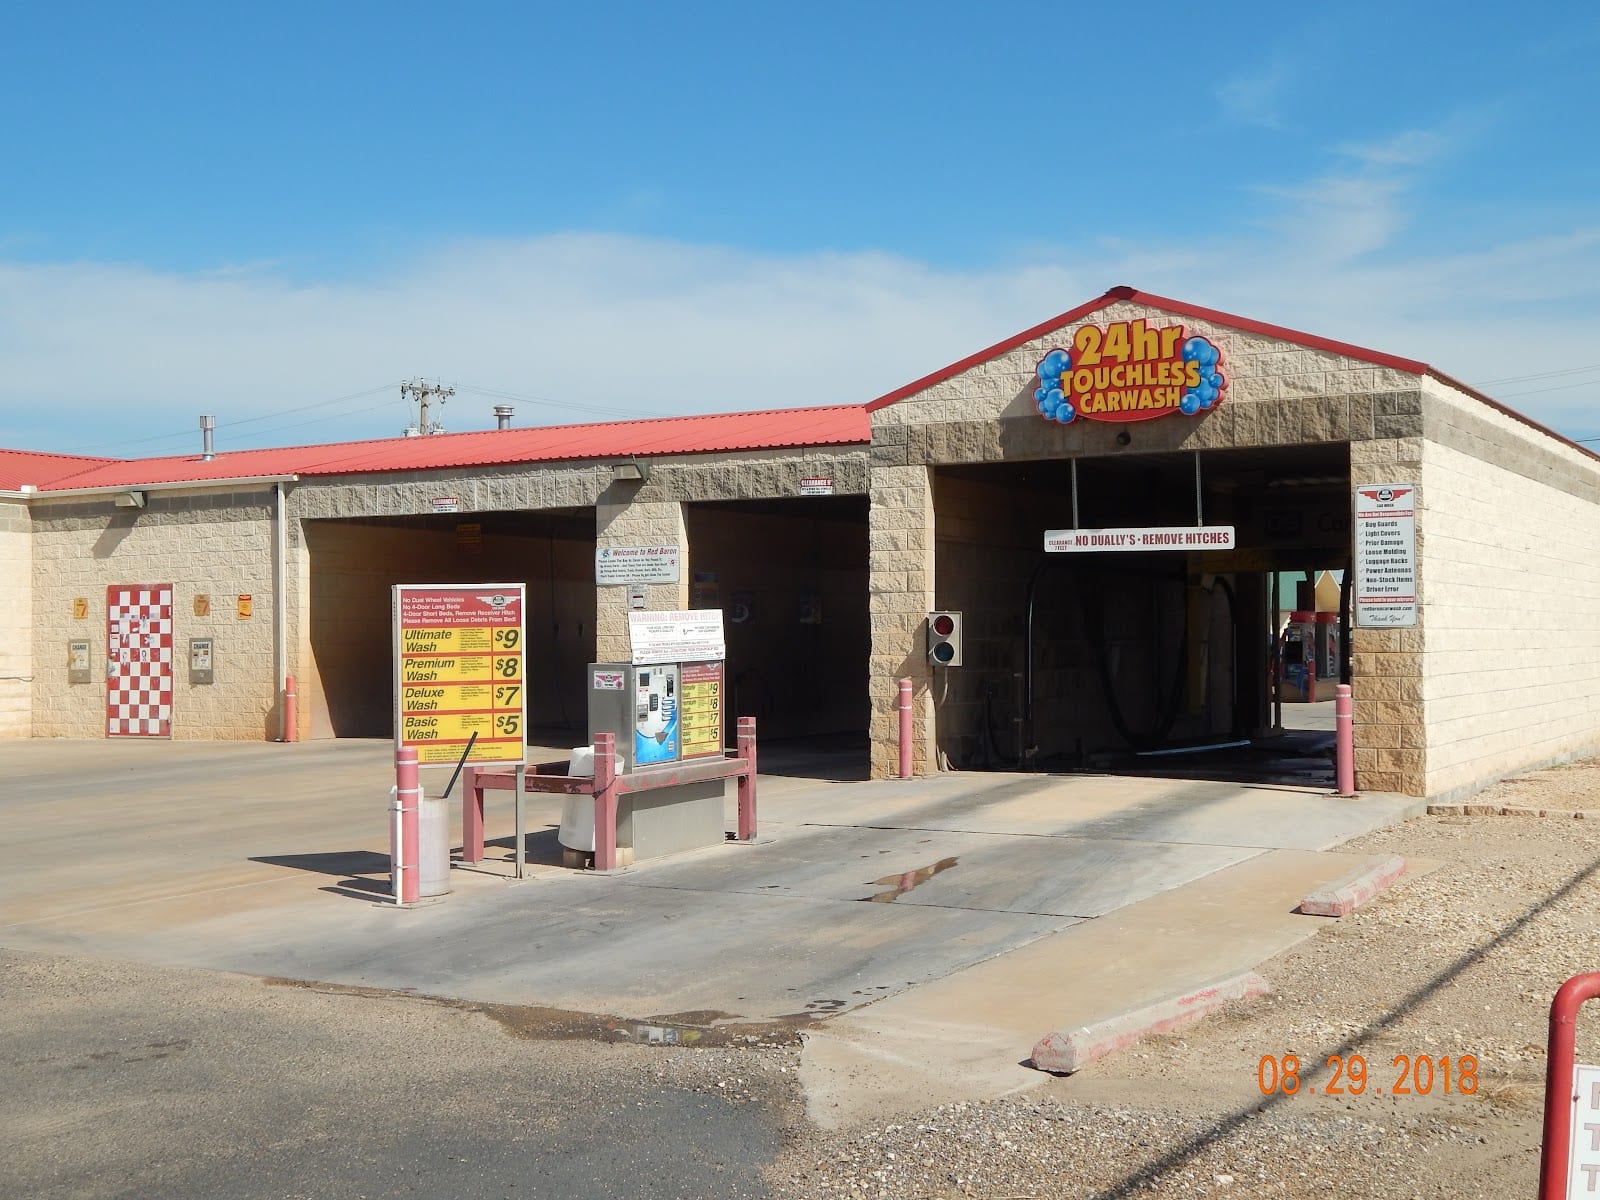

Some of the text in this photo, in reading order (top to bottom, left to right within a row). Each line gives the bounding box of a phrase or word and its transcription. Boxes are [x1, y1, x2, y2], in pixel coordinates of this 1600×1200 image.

[1074, 318, 1183, 366] 24hr
[1060, 361, 1202, 398] TOUCHLESS
[1080, 386, 1181, 414] CARWASH
[1075, 532, 1230, 546] NO DUALLY'S REMOVE HITCHES
[629, 612, 668, 622] WARNING:
[670, 612, 698, 622] REMOVE
[404, 629, 452, 640] Ultimate
[495, 630, 518, 648] $9
[406, 642, 437, 652] Wash
[404, 658, 455, 669] Premium
[496, 658, 518, 677] $8
[407, 670, 437, 681] Wash
[405, 688, 444, 698] Deluxe
[496, 687, 519, 706] $7
[407, 700, 437, 710] Wash
[405, 716, 438, 727] Basic
[496, 716, 519, 734] $5
[407, 729, 438, 739] Wash
